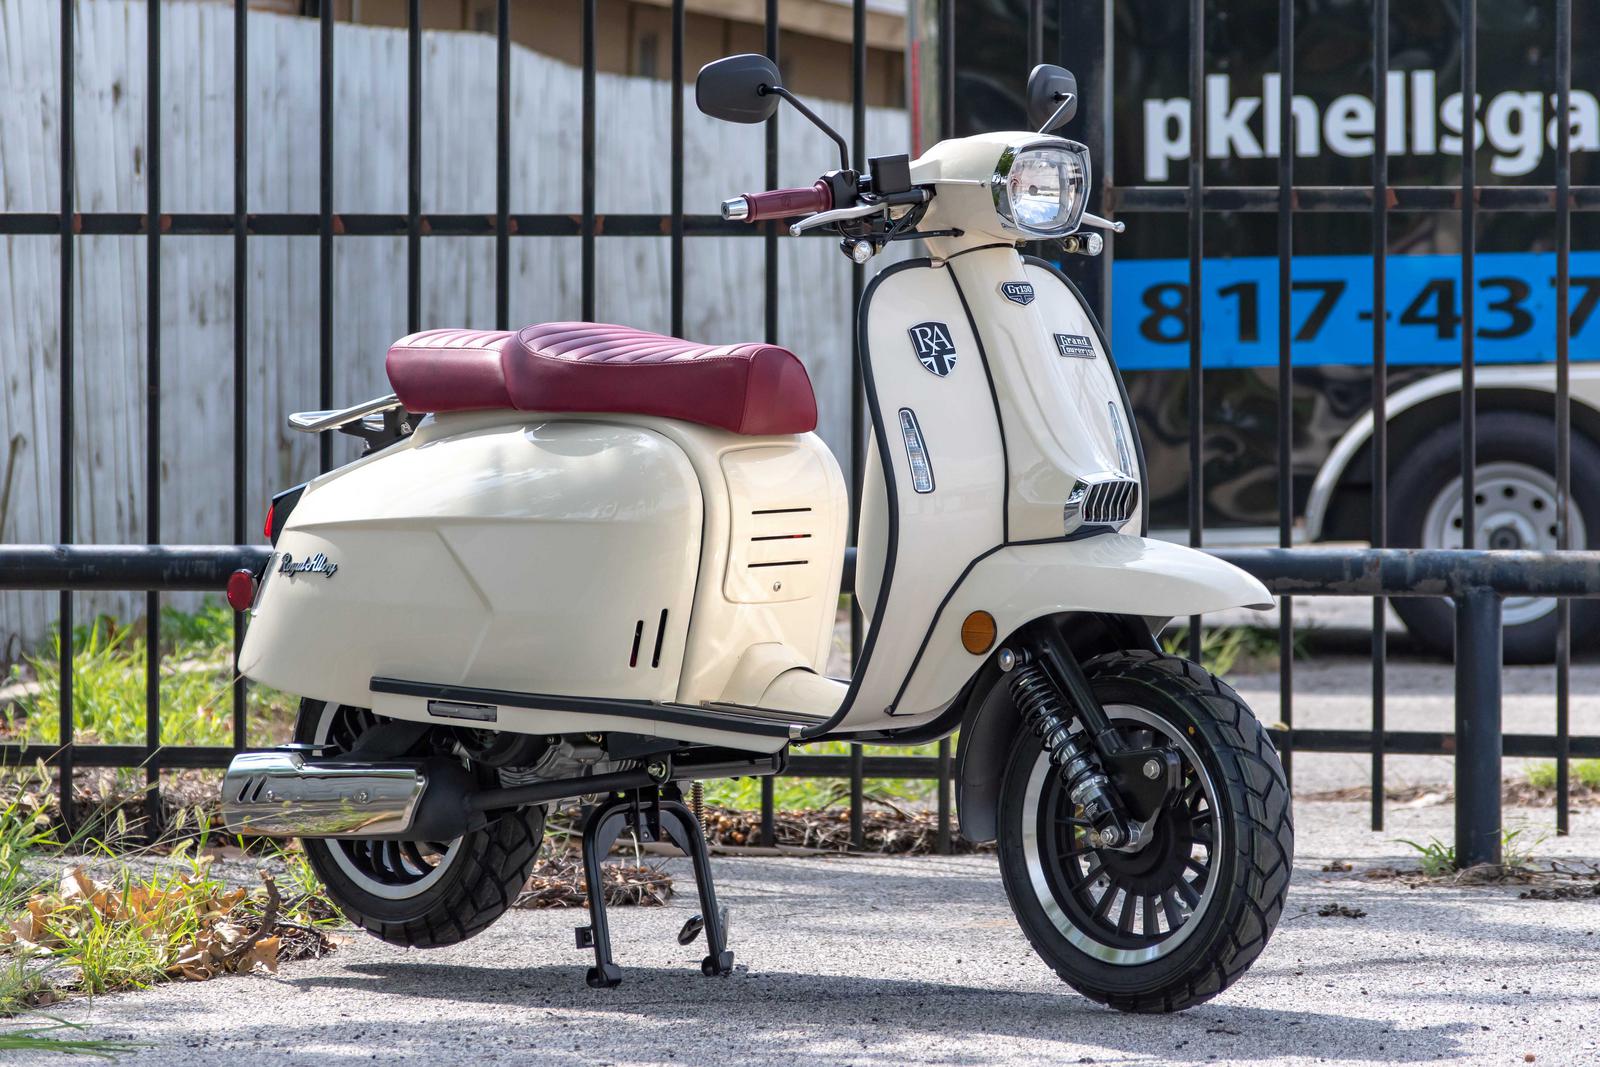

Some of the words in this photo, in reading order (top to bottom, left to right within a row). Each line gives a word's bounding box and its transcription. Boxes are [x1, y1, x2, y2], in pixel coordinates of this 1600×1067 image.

[911, 325, 954, 356] RA
[1060, 335, 1089, 346] Grand
[278, 553, 310, 577] Royal
[305, 553, 338, 578] Alloy
